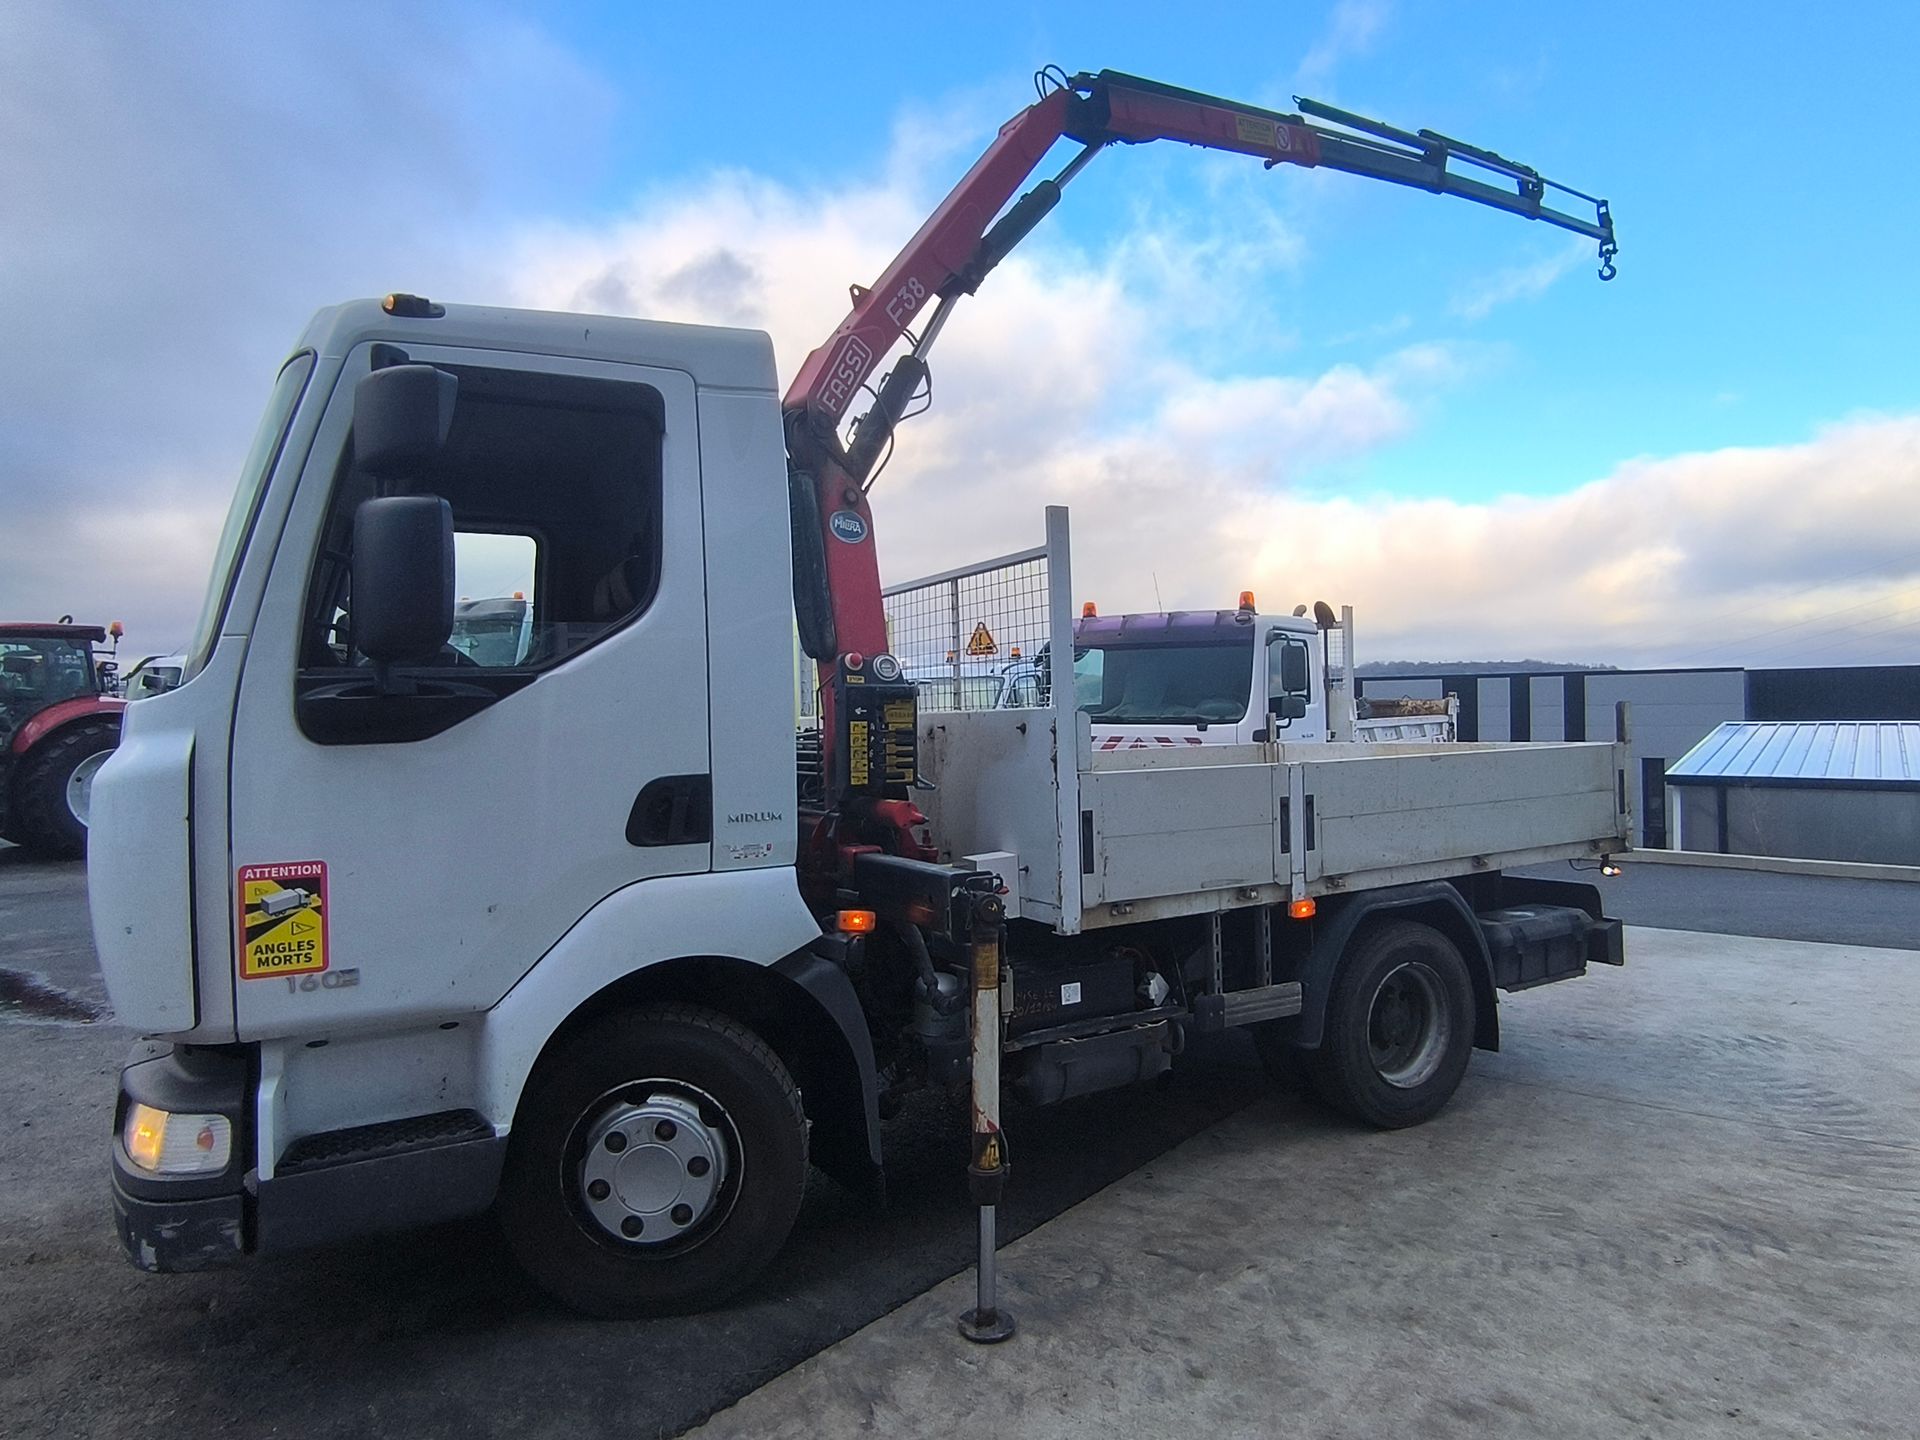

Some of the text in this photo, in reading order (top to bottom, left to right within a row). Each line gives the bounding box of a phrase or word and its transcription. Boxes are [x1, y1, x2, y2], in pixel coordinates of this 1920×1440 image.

[885, 277, 925, 326] F38
[822, 344, 866, 411] FASSI
[728, 812, 782, 823] MIDLUM
[245, 864, 322, 879] ATTENTION
[254, 940, 315, 955] ANGLES
[257, 952, 312, 968] MORTS
